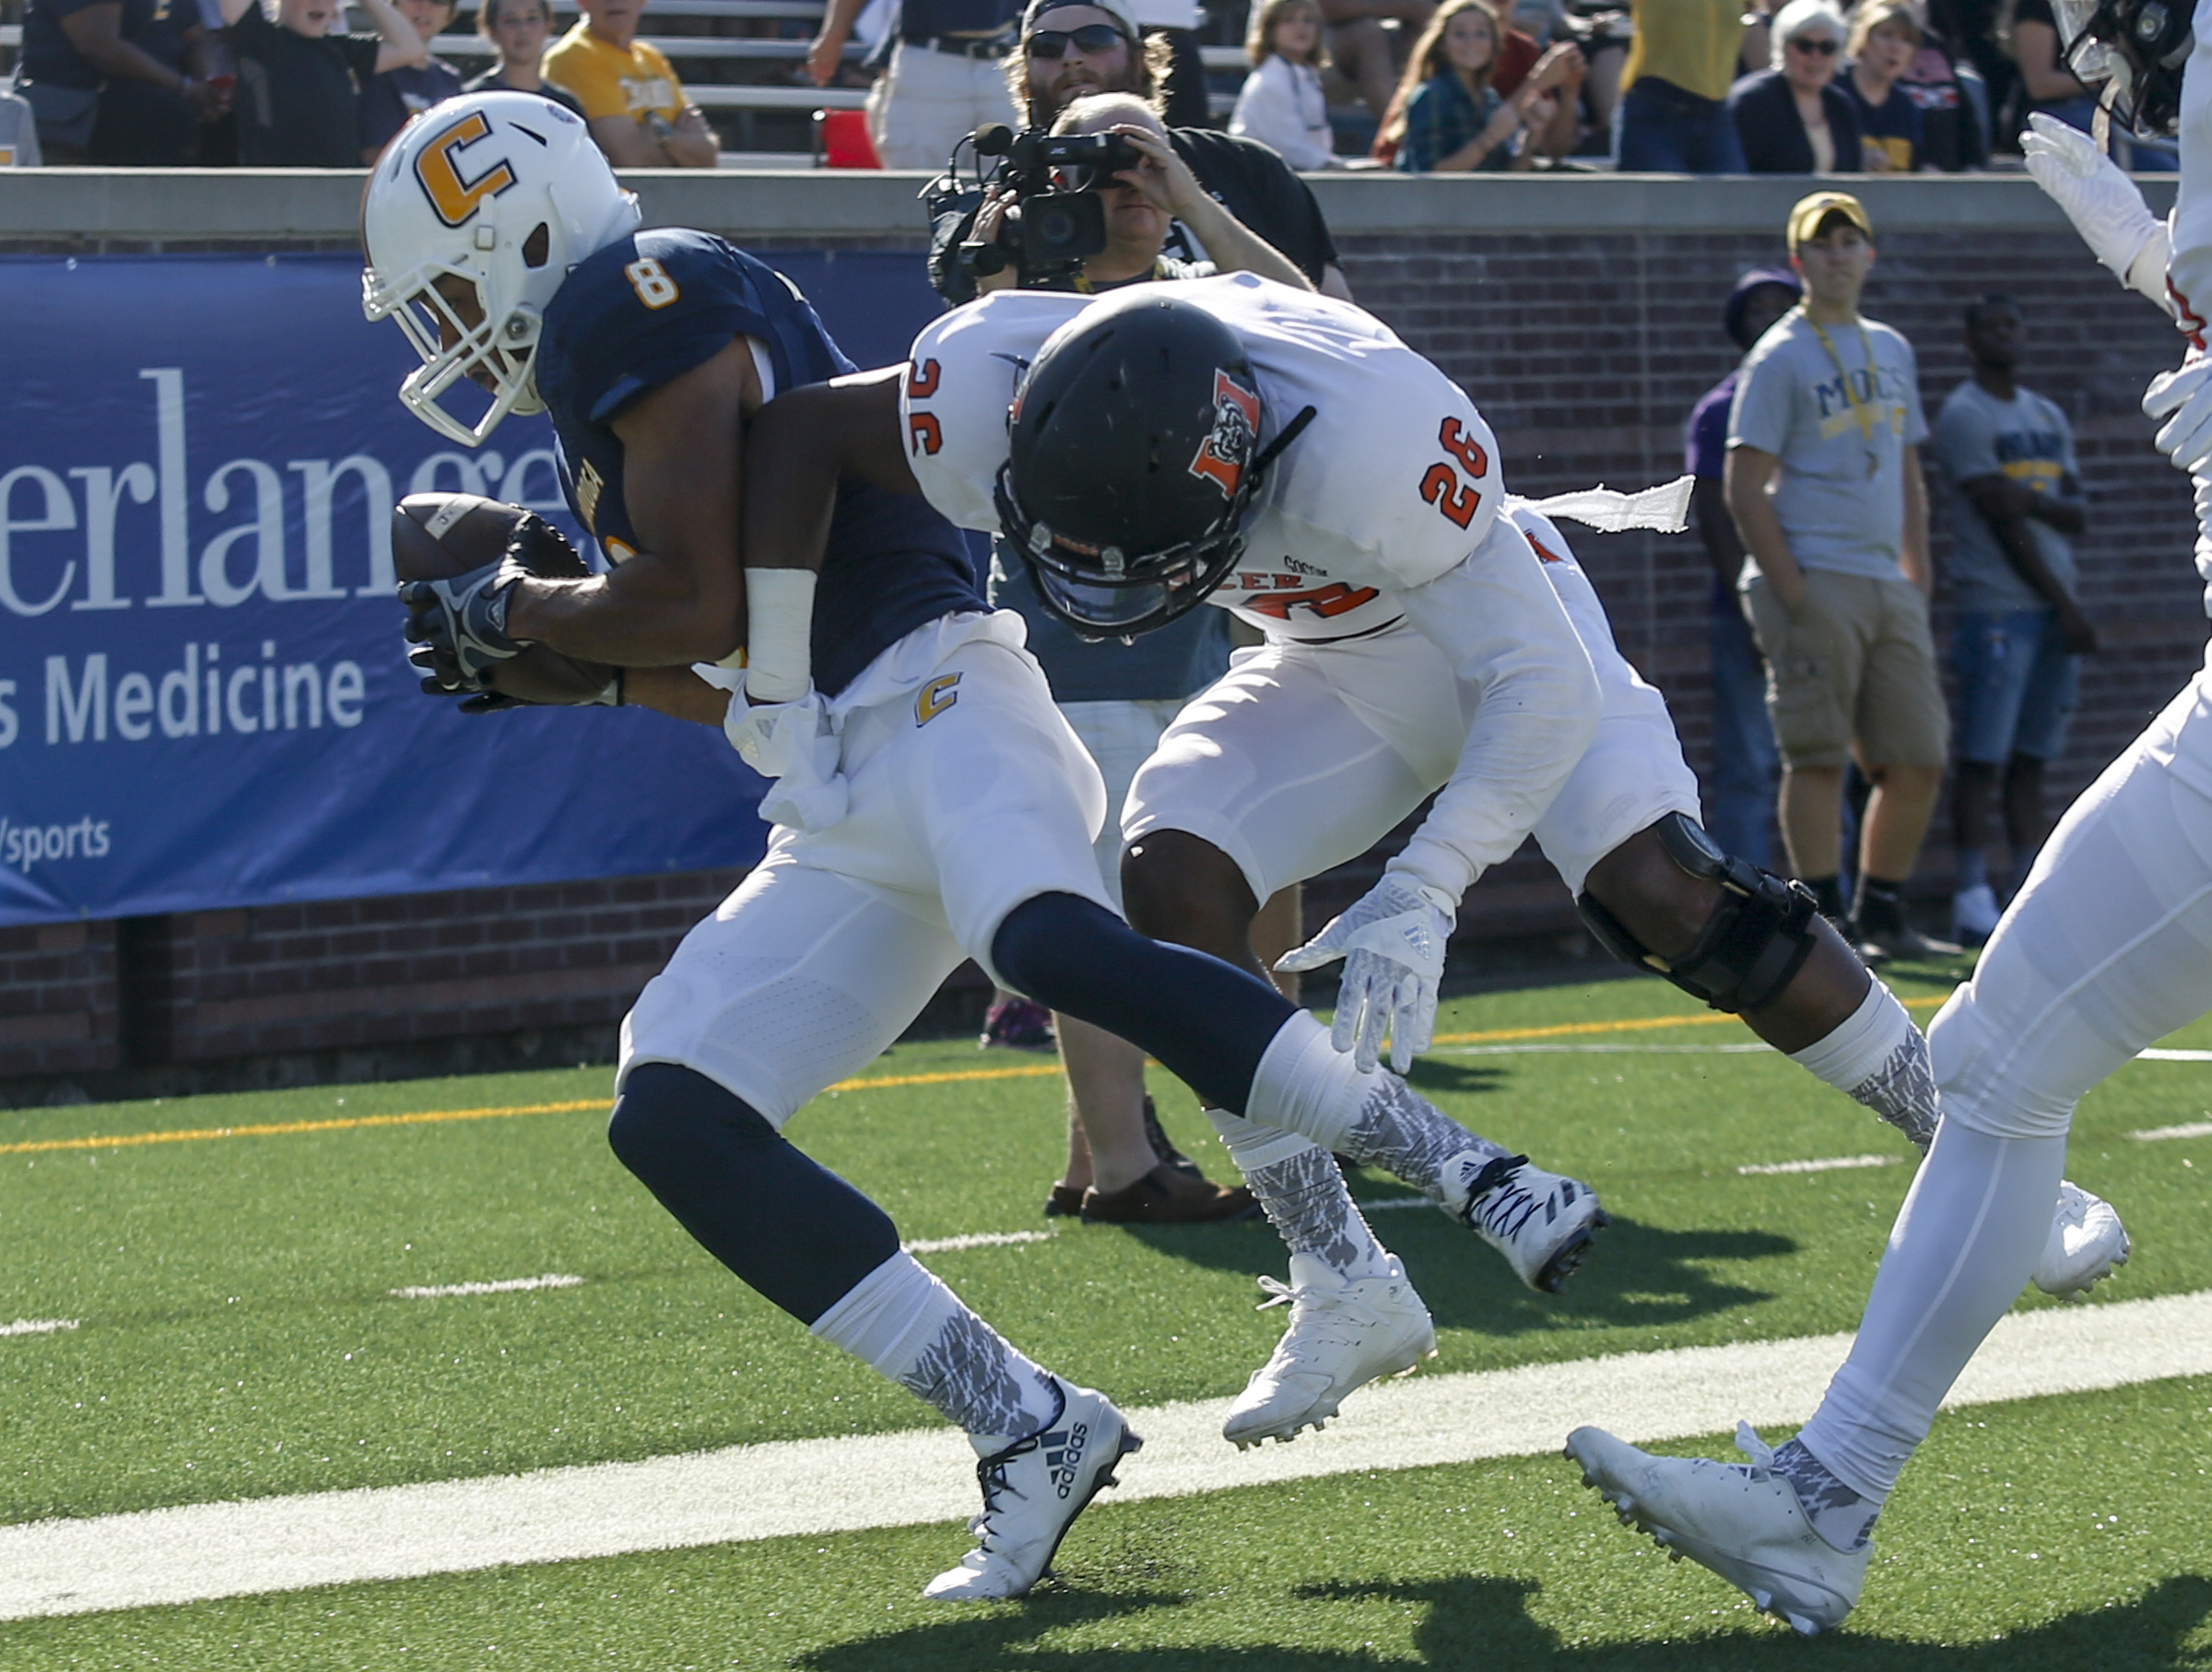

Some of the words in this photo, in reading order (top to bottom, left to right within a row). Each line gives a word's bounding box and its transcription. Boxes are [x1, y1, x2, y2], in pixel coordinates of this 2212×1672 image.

[414, 110, 518, 228] C
[624, 257, 680, 310] 8
[1418, 416, 1488, 531] 26
[46, 640, 365, 745] Medicine
[914, 671, 964, 728] C
[1057, 1421, 1088, 1500] adidas
